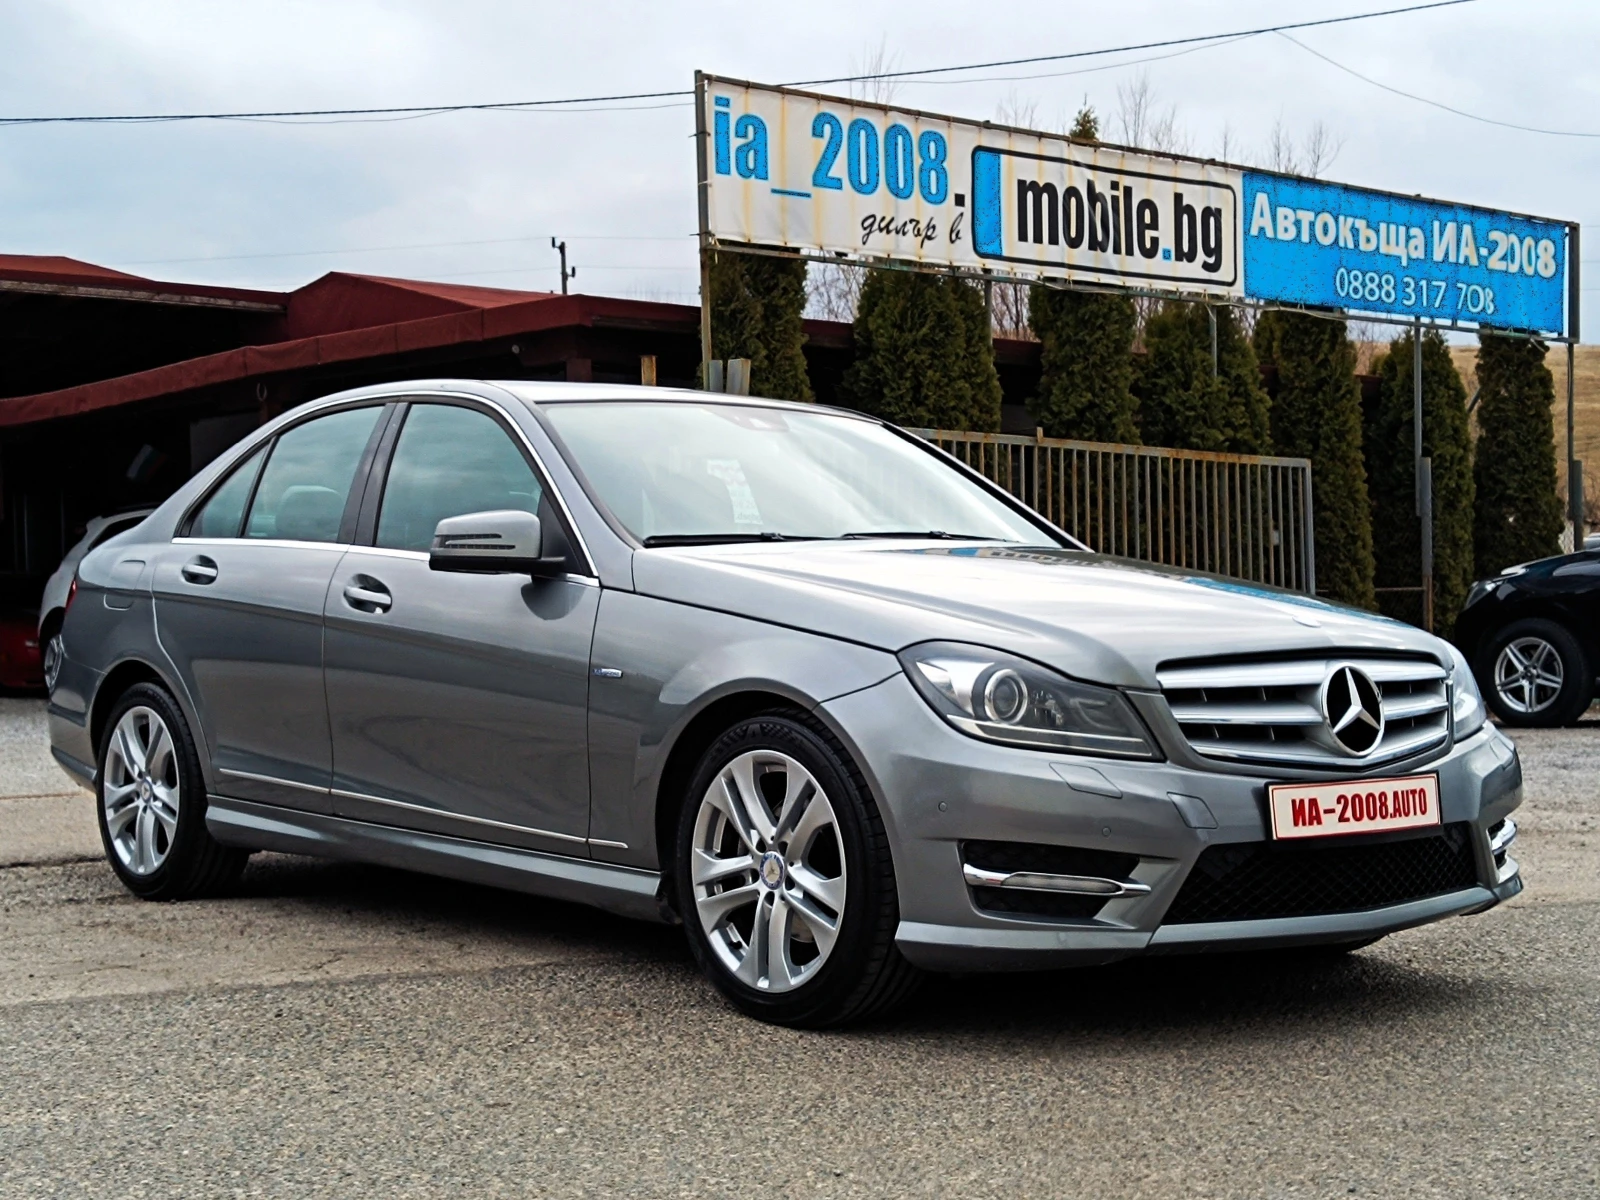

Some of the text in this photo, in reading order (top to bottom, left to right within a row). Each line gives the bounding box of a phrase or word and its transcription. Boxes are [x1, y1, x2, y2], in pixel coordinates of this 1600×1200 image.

[861, 211, 964, 249] дилър в
[1017, 178, 1222, 273] mobile.bg
[1250, 192, 1557, 278] Автокъща ИА-2008
[1335, 267, 1495, 315] 0888 317 708
